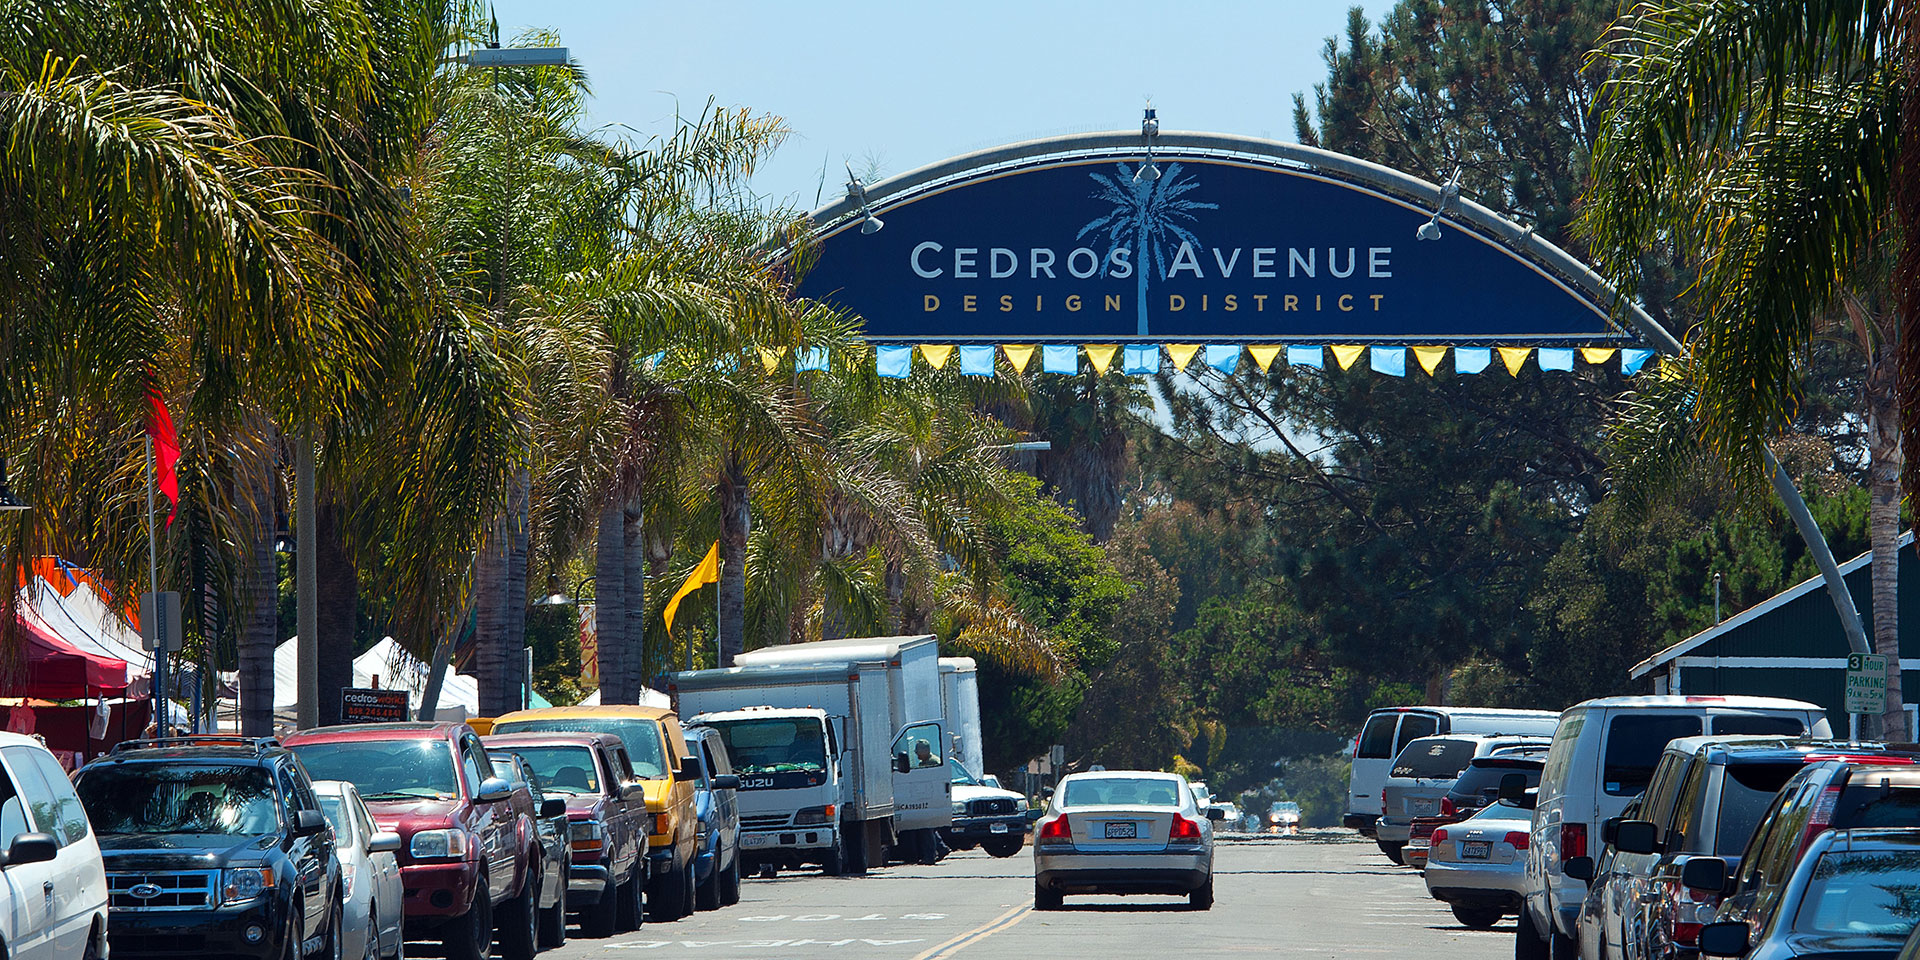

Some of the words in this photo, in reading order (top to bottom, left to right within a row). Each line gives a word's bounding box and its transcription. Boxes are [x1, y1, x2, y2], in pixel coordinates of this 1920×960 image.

[910, 241, 1133, 279] CEDROS
[1167, 240, 1392, 279] AVENUE
[924, 294, 1121, 312] DESIGN
[1169, 294, 1384, 312] DISTRICT
[1850, 656, 1860, 669] 3
[1863, 660, 1884, 671] HOUR
[1849, 675, 1885, 689] PARKING
[344, 693, 405, 705] cedrosworks
[740, 778, 774, 790] SUZU
